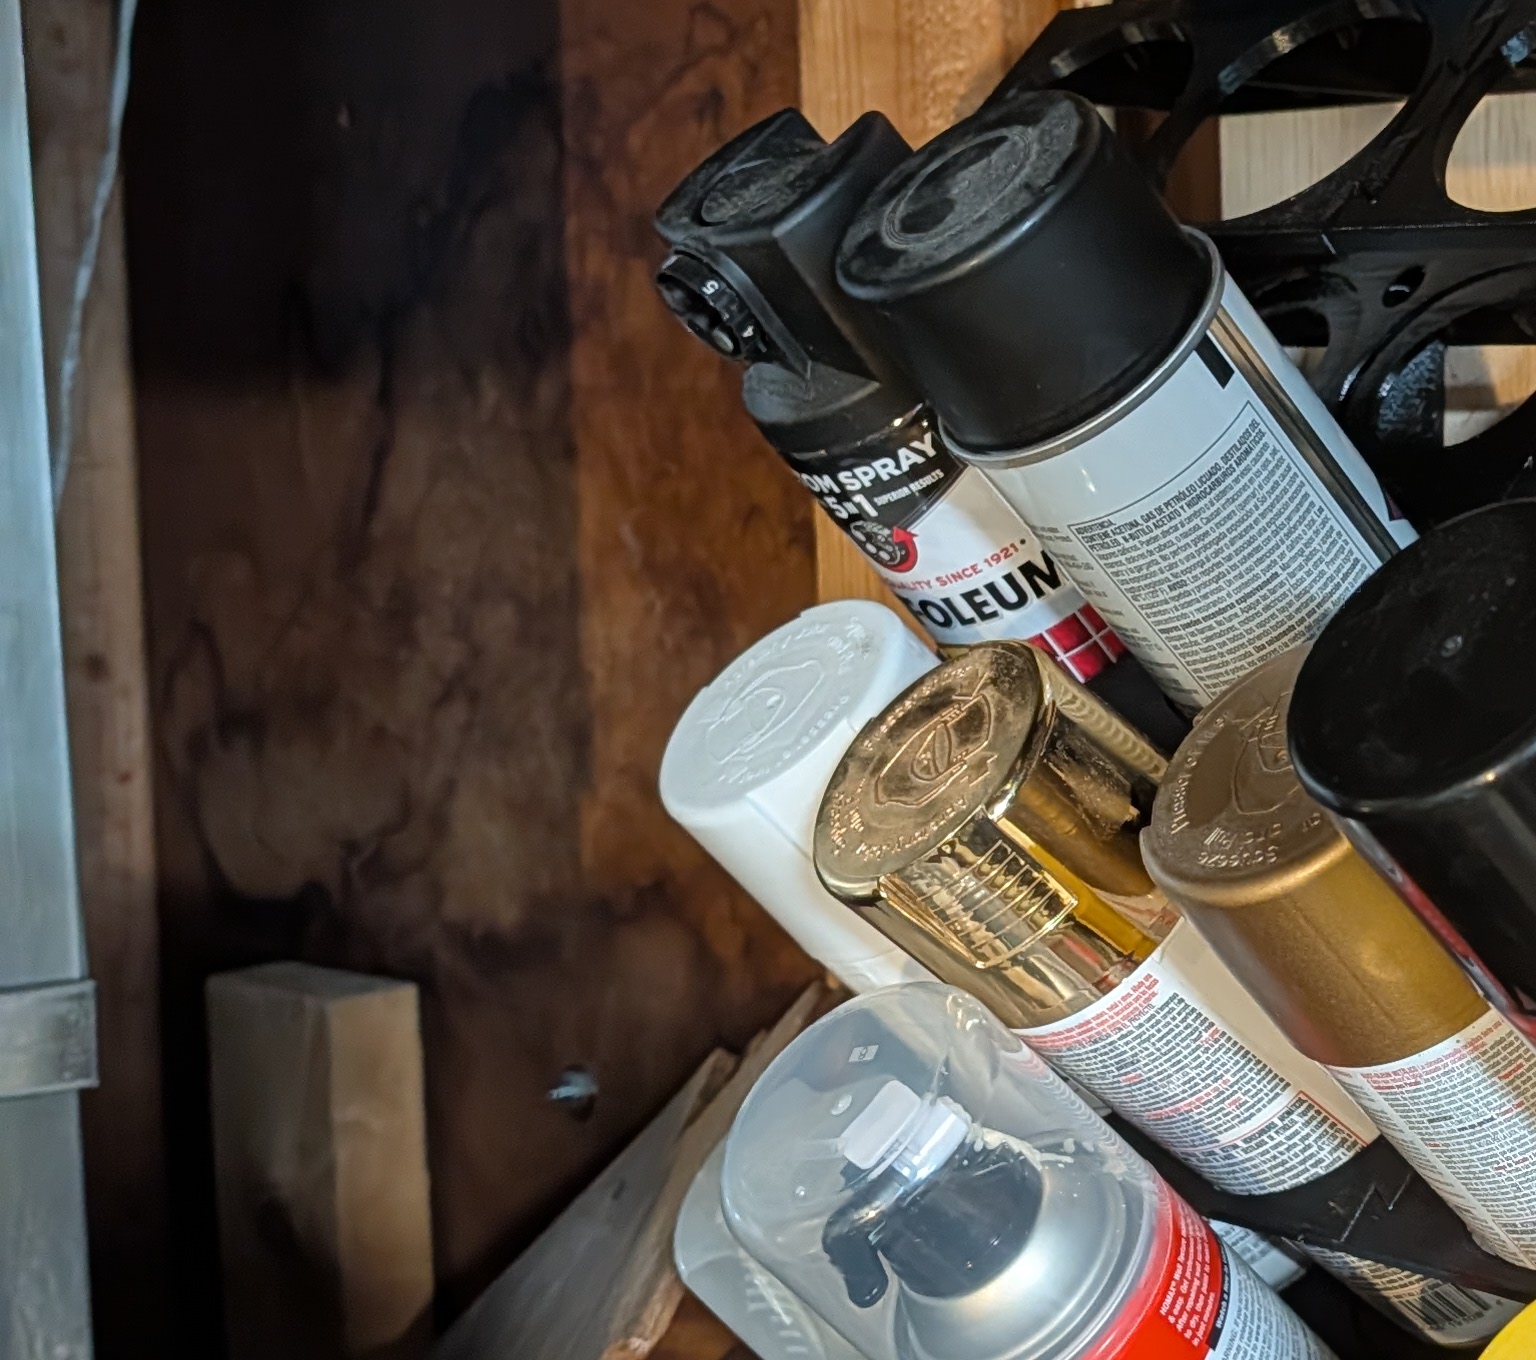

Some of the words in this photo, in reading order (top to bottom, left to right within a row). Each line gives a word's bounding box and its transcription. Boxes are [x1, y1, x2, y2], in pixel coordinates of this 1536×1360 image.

[836, 431, 937, 493] SPRAY
[909, 468, 945, 492] RESULTS
[1109, 517, 1143, 535] ACETONA,
[1140, 510, 1157, 523] GAS
[1153, 505, 1167, 516] DE
[1163, 483, 1198, 511] PETRÓLEO
[1194, 460, 1223, 489] LICUADO,
[1219, 427, 1253, 465] DESTILADOS
[1248, 417, 1260, 433] DEL
[1151, 508, 1182, 529] ACETATO
[1178, 504, 1188, 513] Y
[1184, 463, 1237, 510] HIDROCARBUROS
[934, 561, 983, 588] SINCE
[981, 541, 1020, 569] 1921
